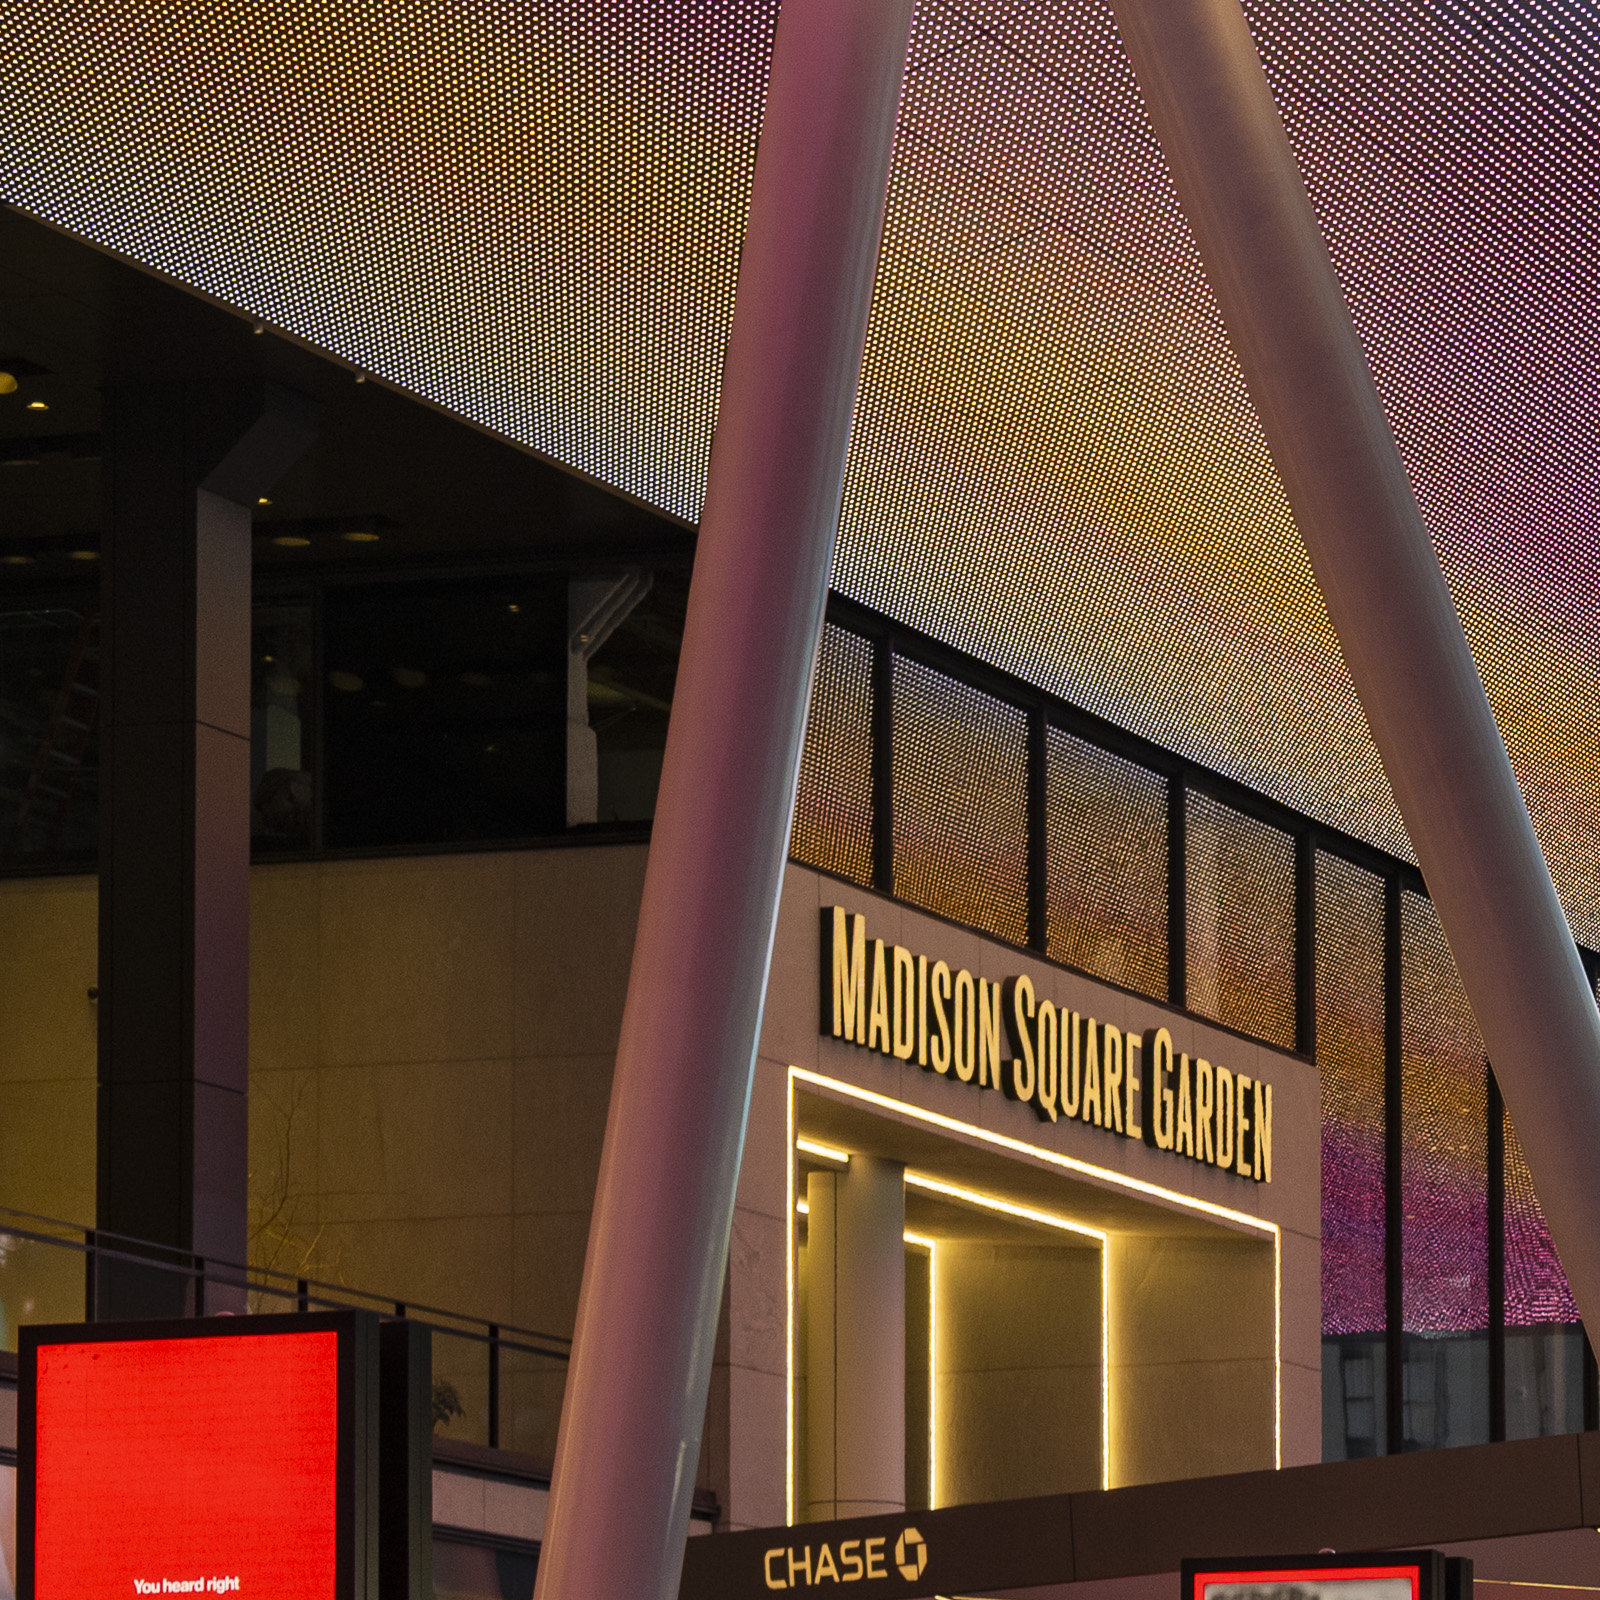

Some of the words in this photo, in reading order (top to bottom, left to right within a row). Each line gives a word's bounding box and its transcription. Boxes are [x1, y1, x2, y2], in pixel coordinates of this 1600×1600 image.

[829, 905, 1001, 1091] MADISON
[1008, 973, 1143, 1142] SQUARE
[1150, 1026, 1273, 1184] GARDEN
[134, 1579, 160, 1594] You
[162, 1577, 204, 1592] heard
[206, 1576, 240, 1594] right
[764, 1536, 887, 1590] CHASE
